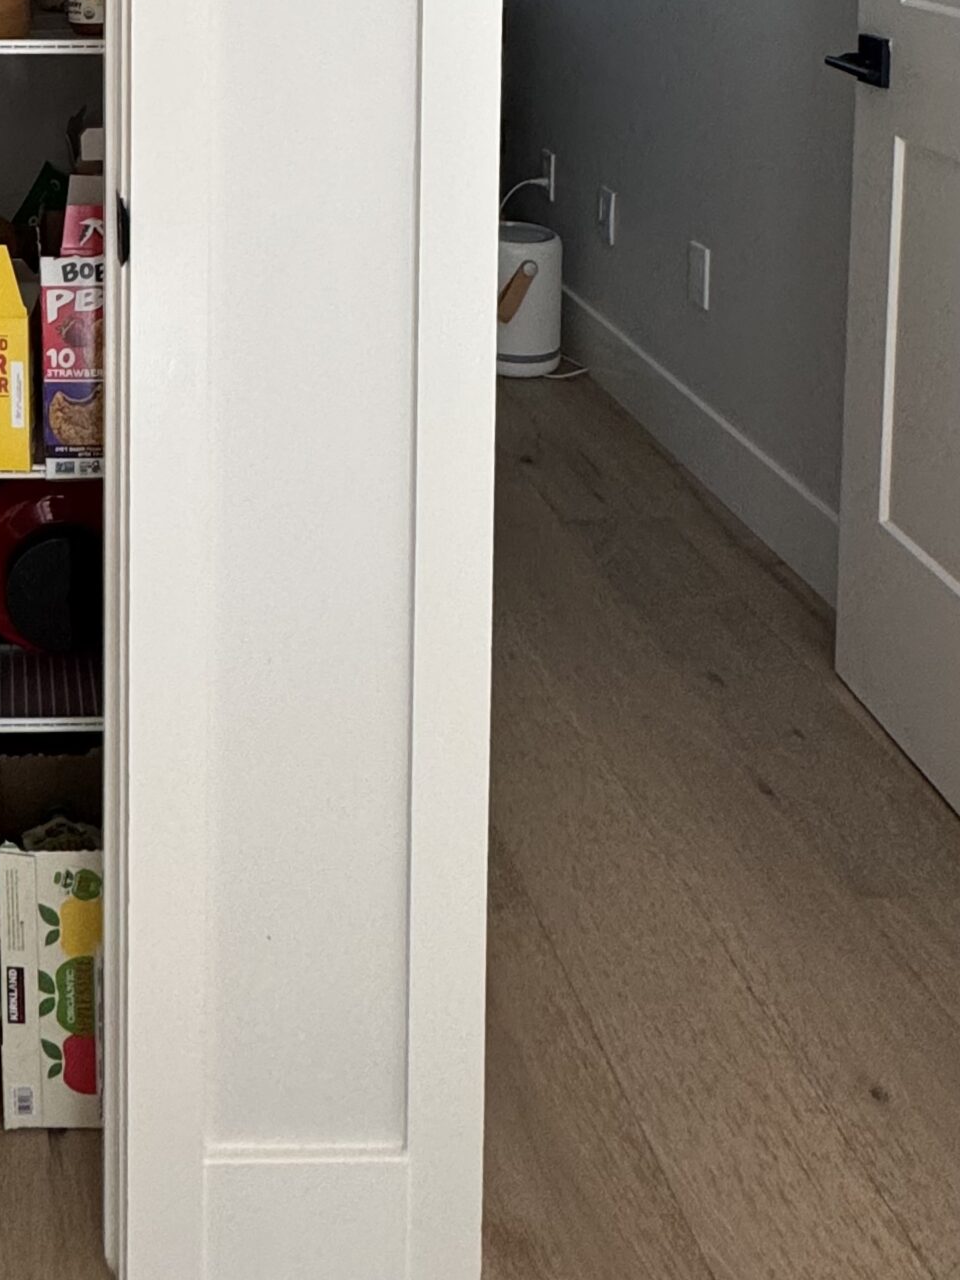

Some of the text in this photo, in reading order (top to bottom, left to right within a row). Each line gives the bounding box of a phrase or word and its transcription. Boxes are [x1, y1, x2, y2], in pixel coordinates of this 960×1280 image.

[46, 347, 76, 368] 10
[8, 968, 19, 1022] KIRKLAND
[65, 969, 76, 1024] ORGANIC
